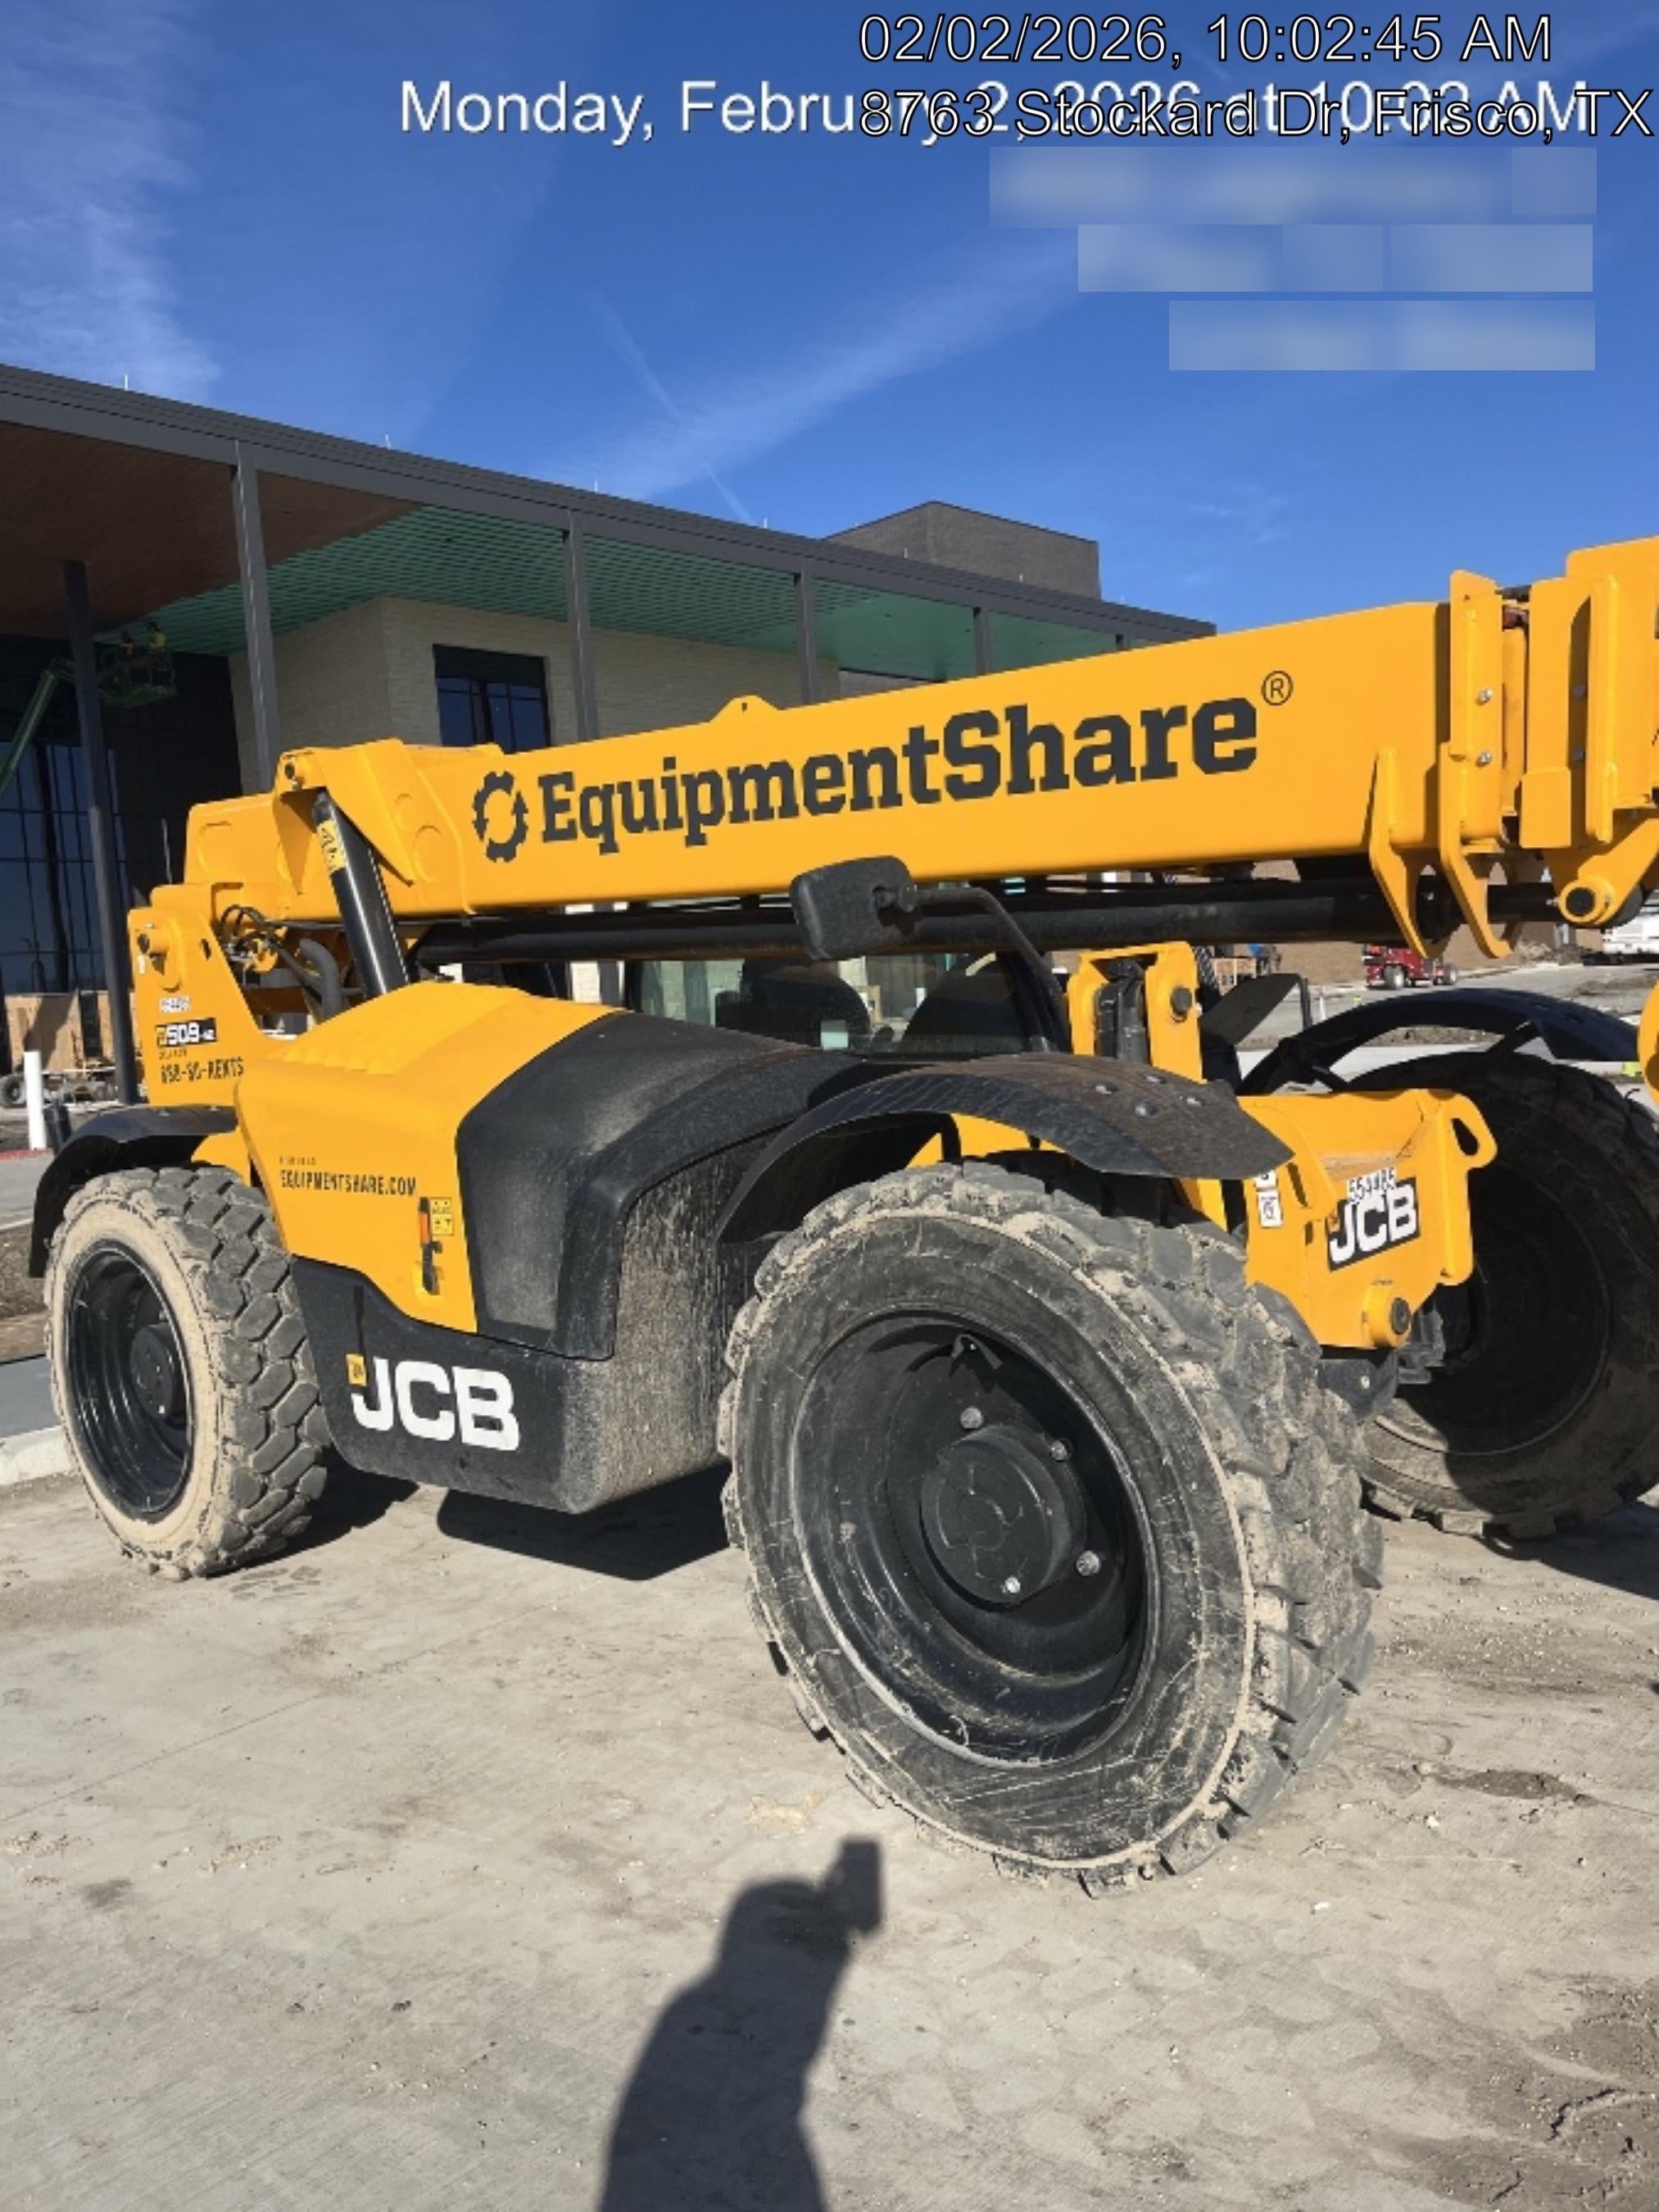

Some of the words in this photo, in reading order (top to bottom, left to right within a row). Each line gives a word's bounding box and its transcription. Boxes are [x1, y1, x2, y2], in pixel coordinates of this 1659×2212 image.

[280, 1169, 416, 1196] EQUIPMENTSHARE.COM
[1329, 1184, 1417, 1263] JCB
[351, 1356, 520, 1451] JCB
